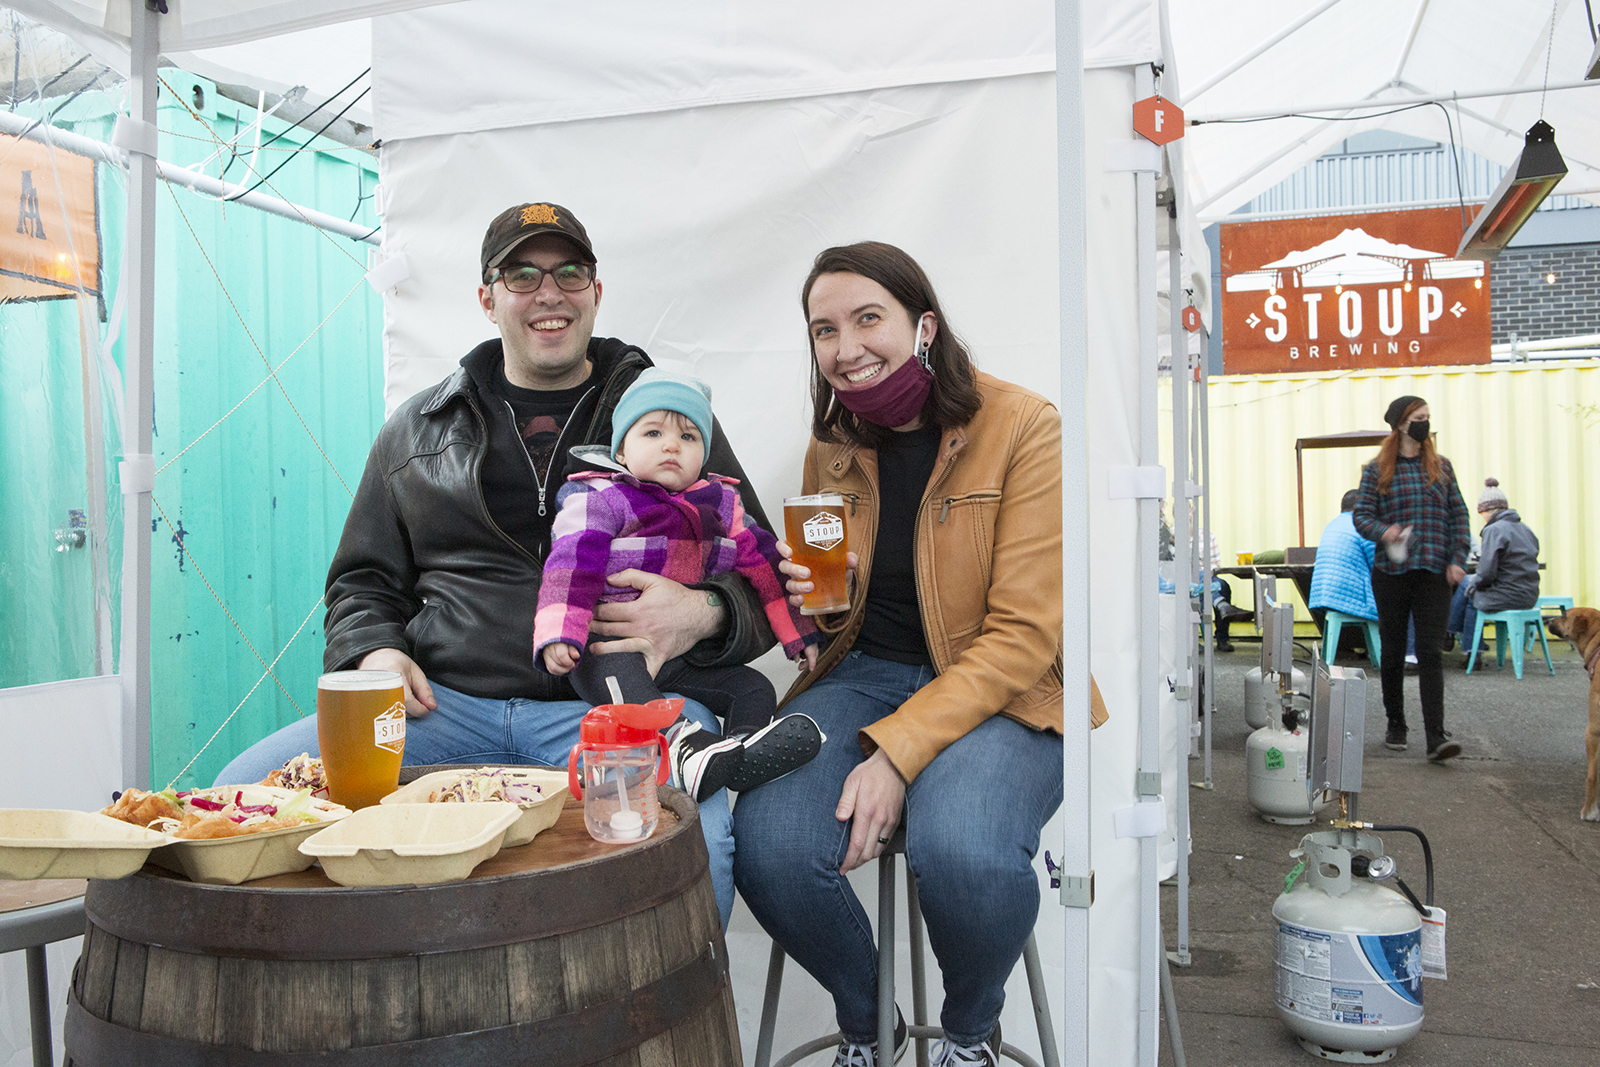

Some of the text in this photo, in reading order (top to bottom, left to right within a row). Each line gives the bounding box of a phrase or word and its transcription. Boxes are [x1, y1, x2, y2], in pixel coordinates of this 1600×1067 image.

[1154, 109, 1165, 133] F
[1188, 312, 1195, 326] G
[1264, 286, 1443, 343] STOUP
[1290, 340, 1420, 360] BREWING
[809, 526, 840, 538] STOUP
